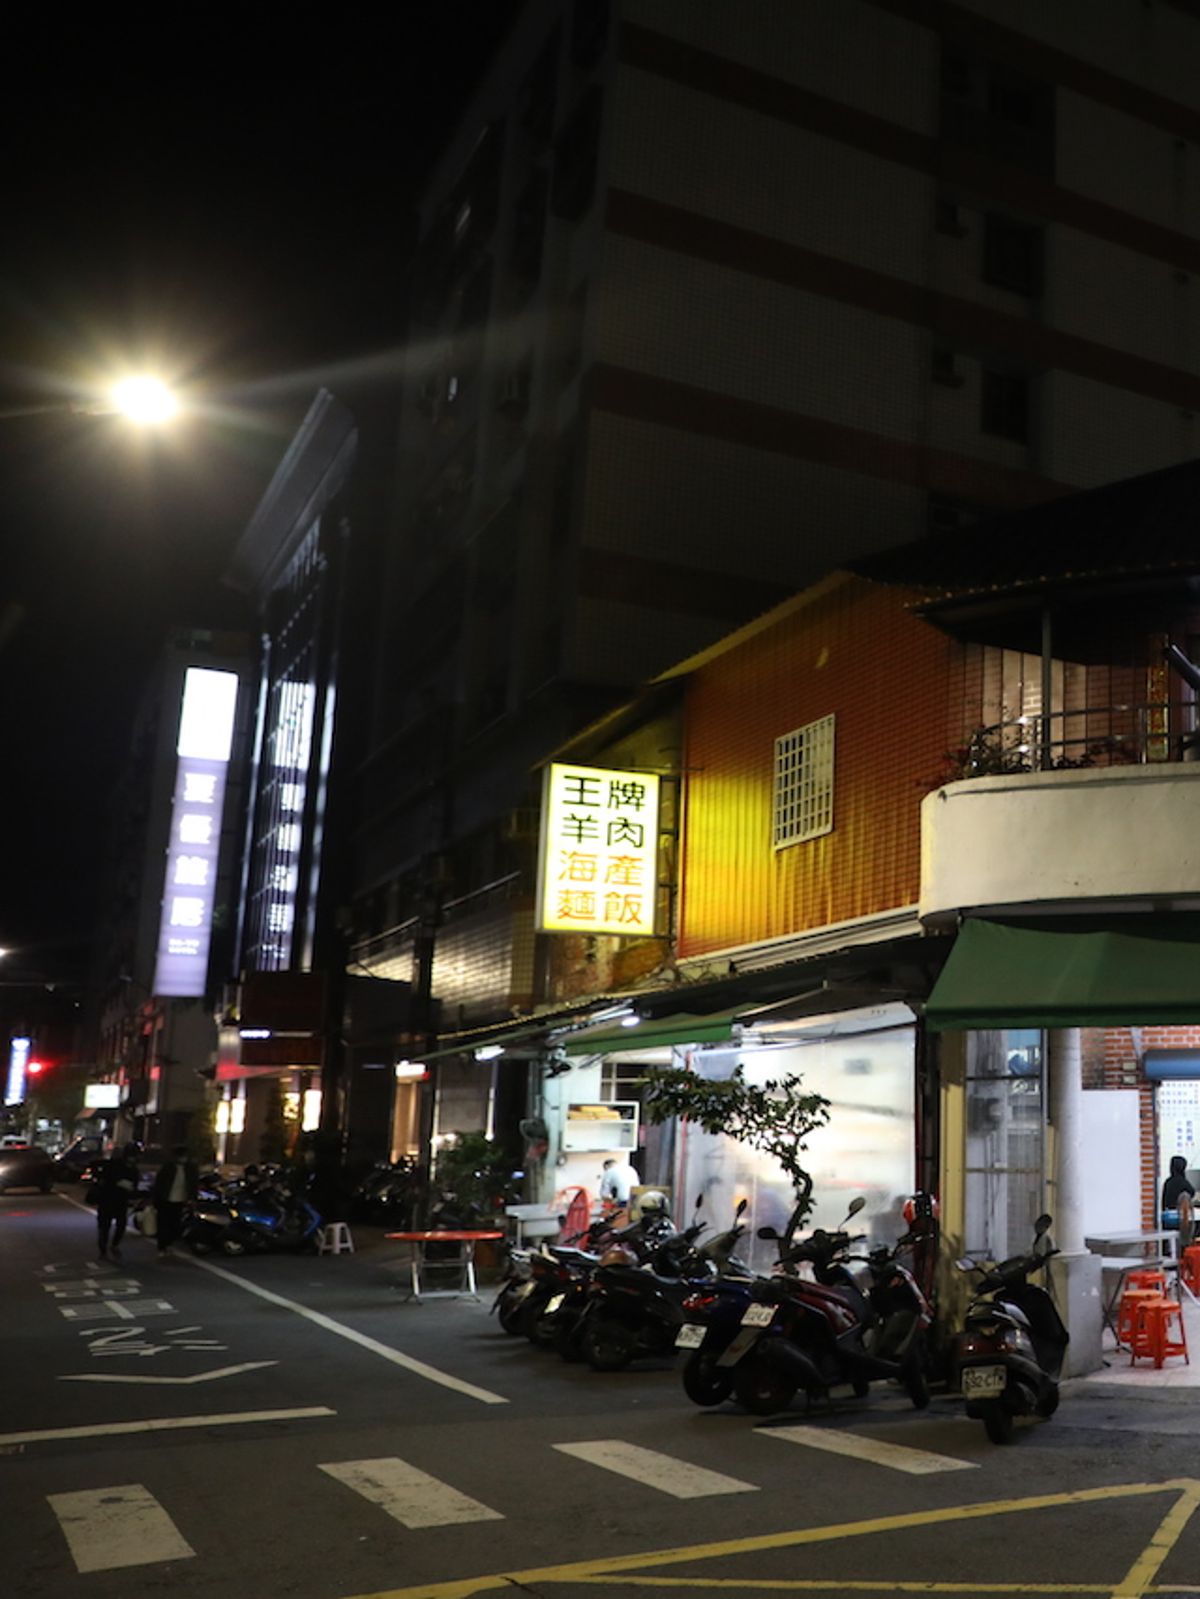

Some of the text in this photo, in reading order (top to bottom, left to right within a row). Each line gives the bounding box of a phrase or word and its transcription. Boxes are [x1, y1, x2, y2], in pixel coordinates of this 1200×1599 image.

[562, 775, 646, 812] 王牌
[560, 813, 644, 849] 羊肉
[558, 850, 645, 887] 海產
[556, 889, 643, 925] 麵飯
